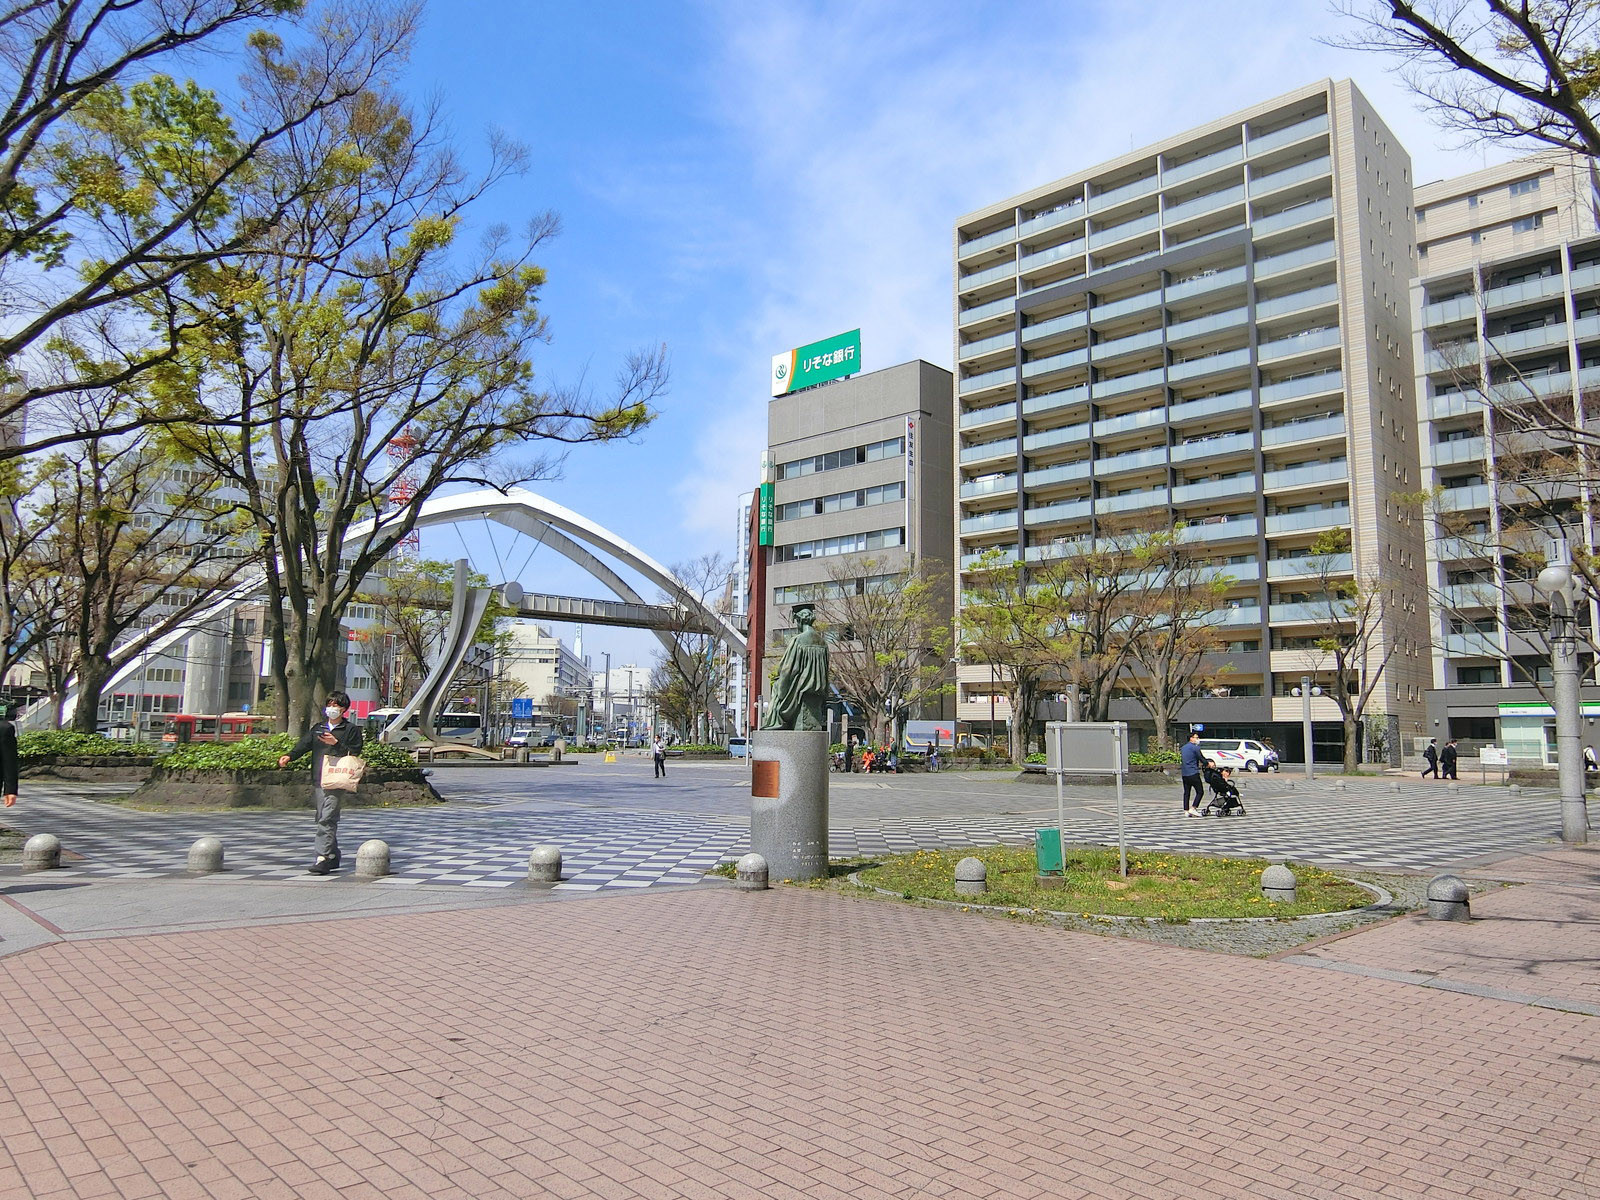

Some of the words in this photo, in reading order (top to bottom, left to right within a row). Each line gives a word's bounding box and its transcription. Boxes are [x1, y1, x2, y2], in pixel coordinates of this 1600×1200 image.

[803, 345, 855, 373] りそな銀行
